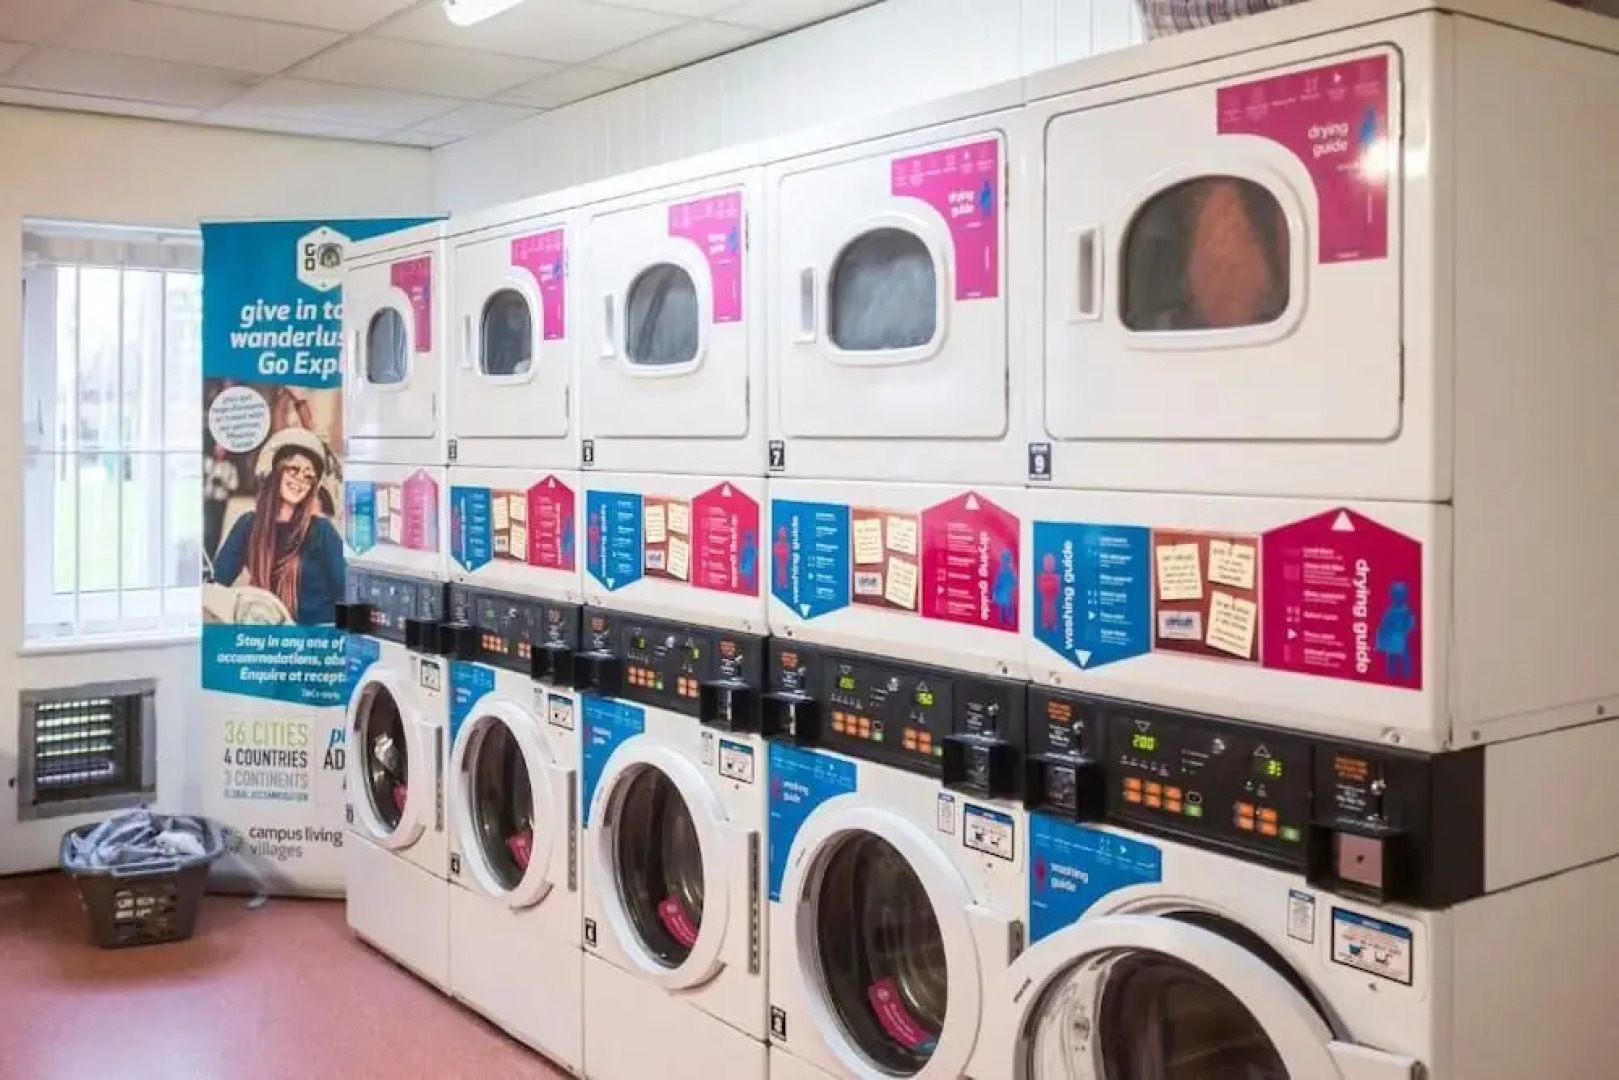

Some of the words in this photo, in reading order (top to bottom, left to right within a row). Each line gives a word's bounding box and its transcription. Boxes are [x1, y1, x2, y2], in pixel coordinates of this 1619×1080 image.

[1307, 122, 1350, 139] drying
[1312, 139, 1348, 159] guide
[239, 298, 291, 329] give
[296, 297, 318, 321] in
[258, 350, 289, 375] Go
[1062, 540, 1075, 584] guide
[1352, 558, 1371, 618] drying
[1062, 585, 1075, 650] washing
[235, 632, 266, 651] Stay
[267, 634, 280, 647] in
[280, 636, 304, 652] any
[305, 638, 330, 649] one
[331, 635, 346, 653] of
[1352, 621, 1371, 674] guide
[240, 665, 286, 684] Enquire
[287, 669, 302, 681] at
[224, 719, 247, 744] 36
[252, 720, 309, 746] CITIES
[223, 747, 233, 764] 4
[235, 747, 308, 768] COUNTRIES
[234, 769, 309, 789] CONTINENTS
[248, 827, 303, 843] campus
[305, 825, 343, 848] living
[249, 842, 304, 861] villages
